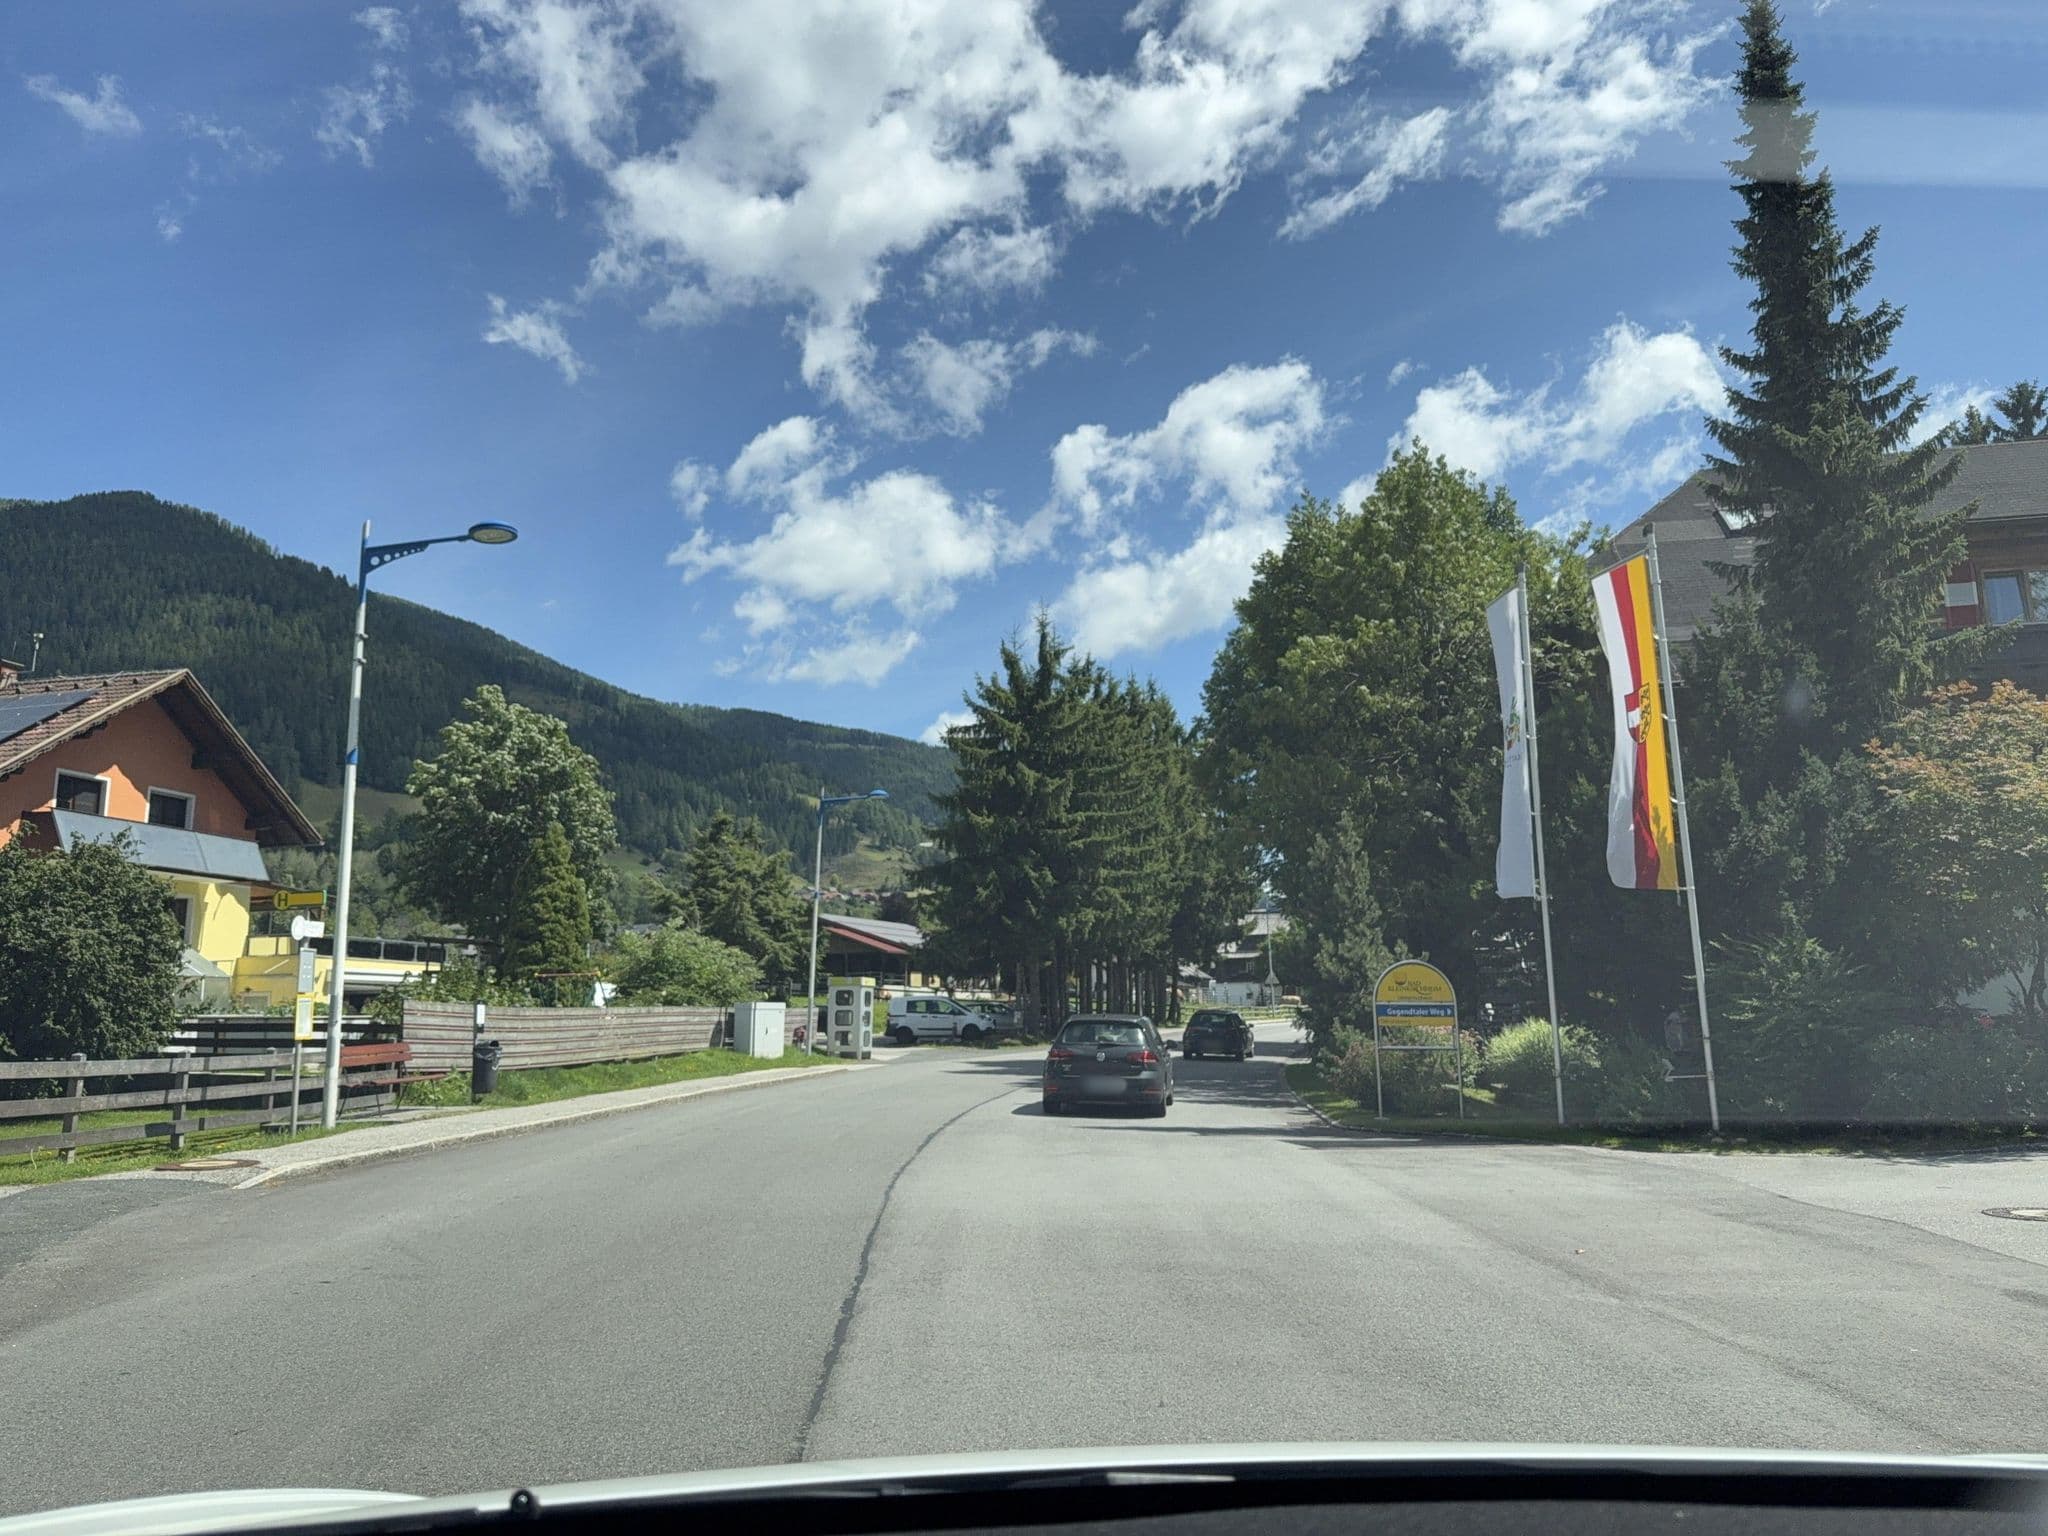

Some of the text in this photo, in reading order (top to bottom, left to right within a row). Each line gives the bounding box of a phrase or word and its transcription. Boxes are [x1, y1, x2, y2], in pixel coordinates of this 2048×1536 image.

[278, 893, 288, 907] H
[1386, 1007, 1445, 1017] Gegendtaler Weg
